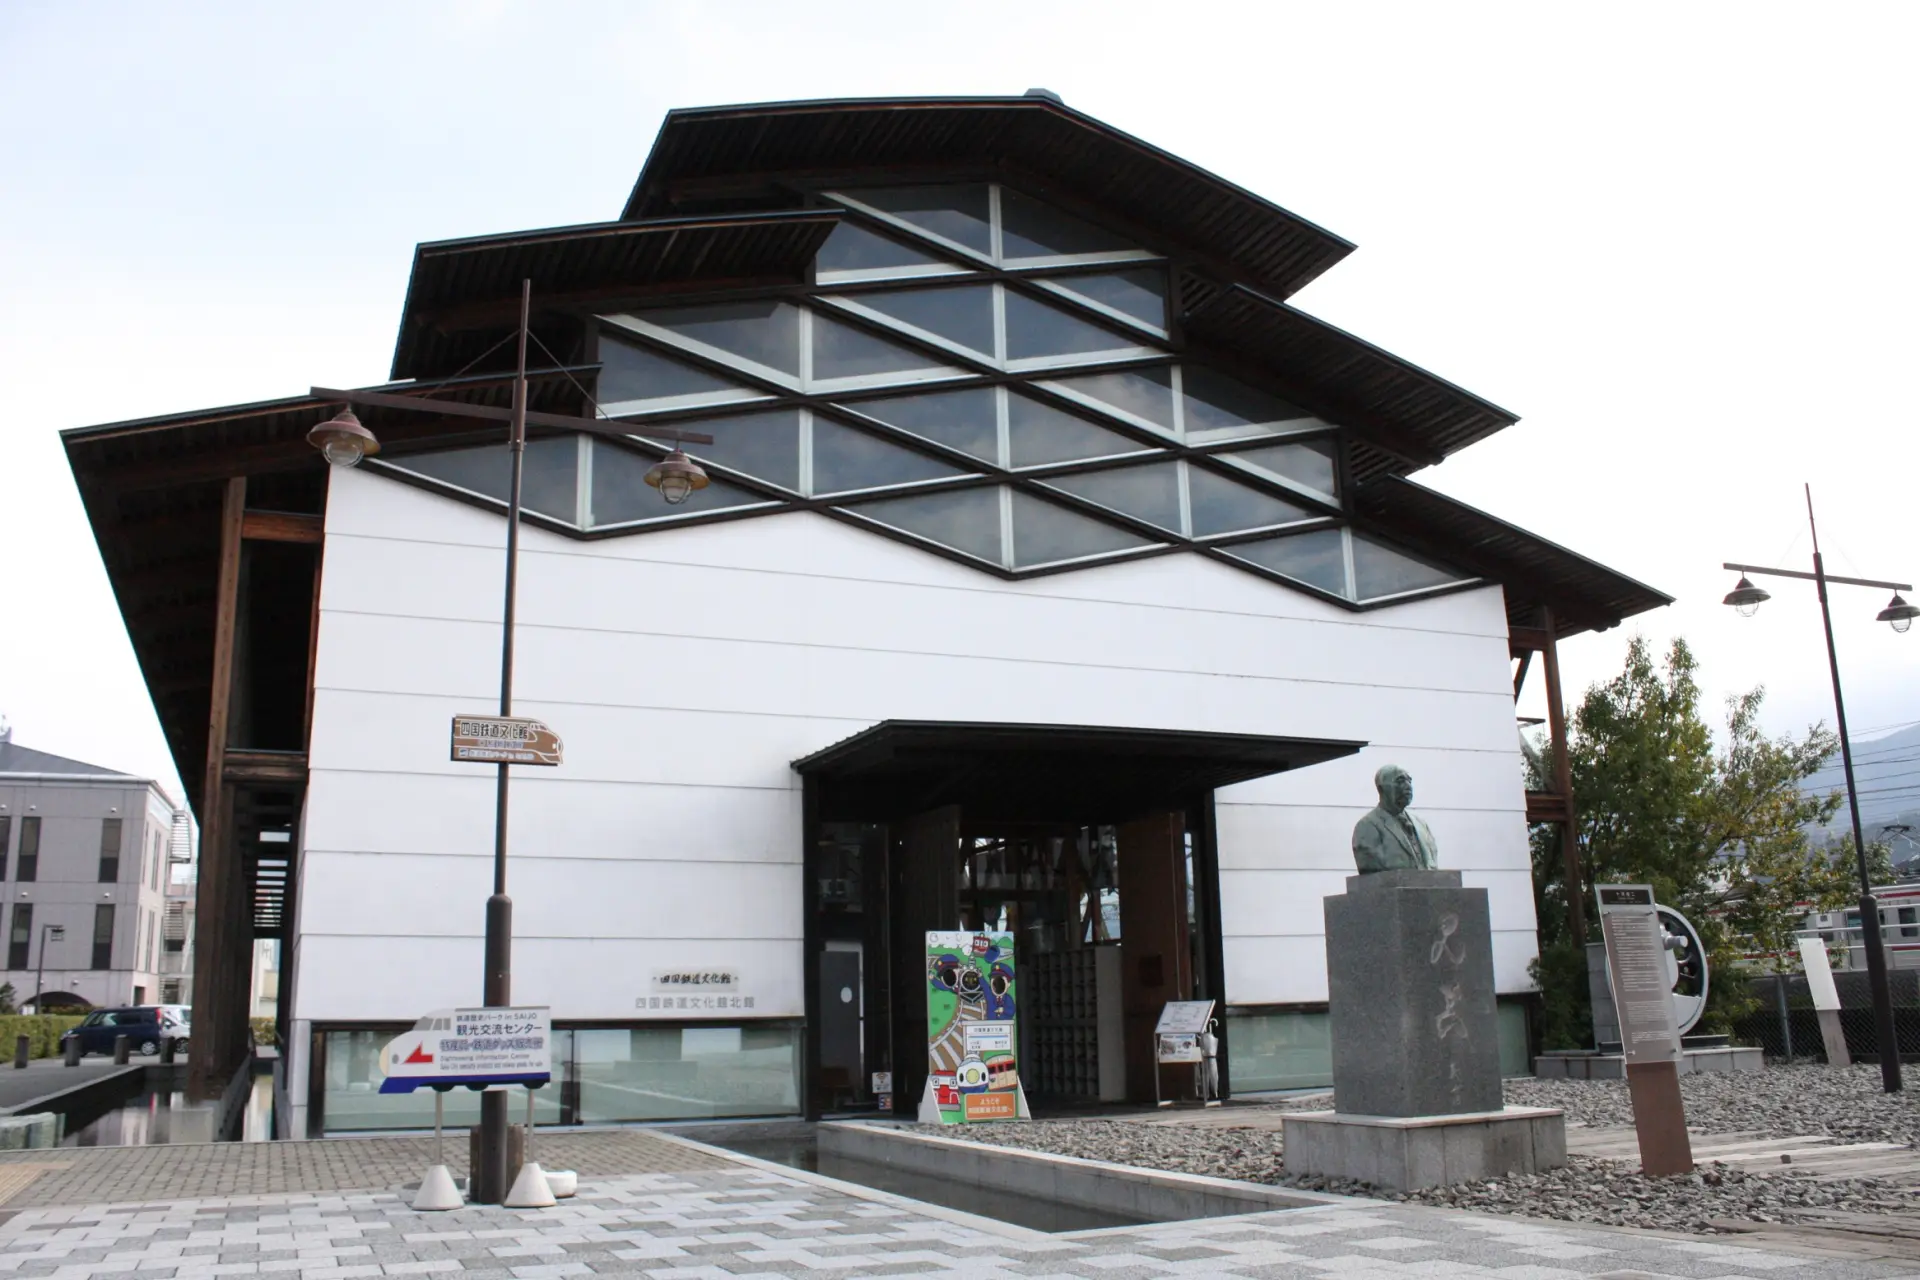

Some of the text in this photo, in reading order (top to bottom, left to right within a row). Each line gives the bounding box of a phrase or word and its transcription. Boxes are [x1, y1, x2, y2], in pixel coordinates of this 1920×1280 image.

[461, 722, 529, 739] 四国鉄道文化館
[514, 1012, 537, 1020] SAIJO
[456, 1023, 543, 1036] 観光交流センター
